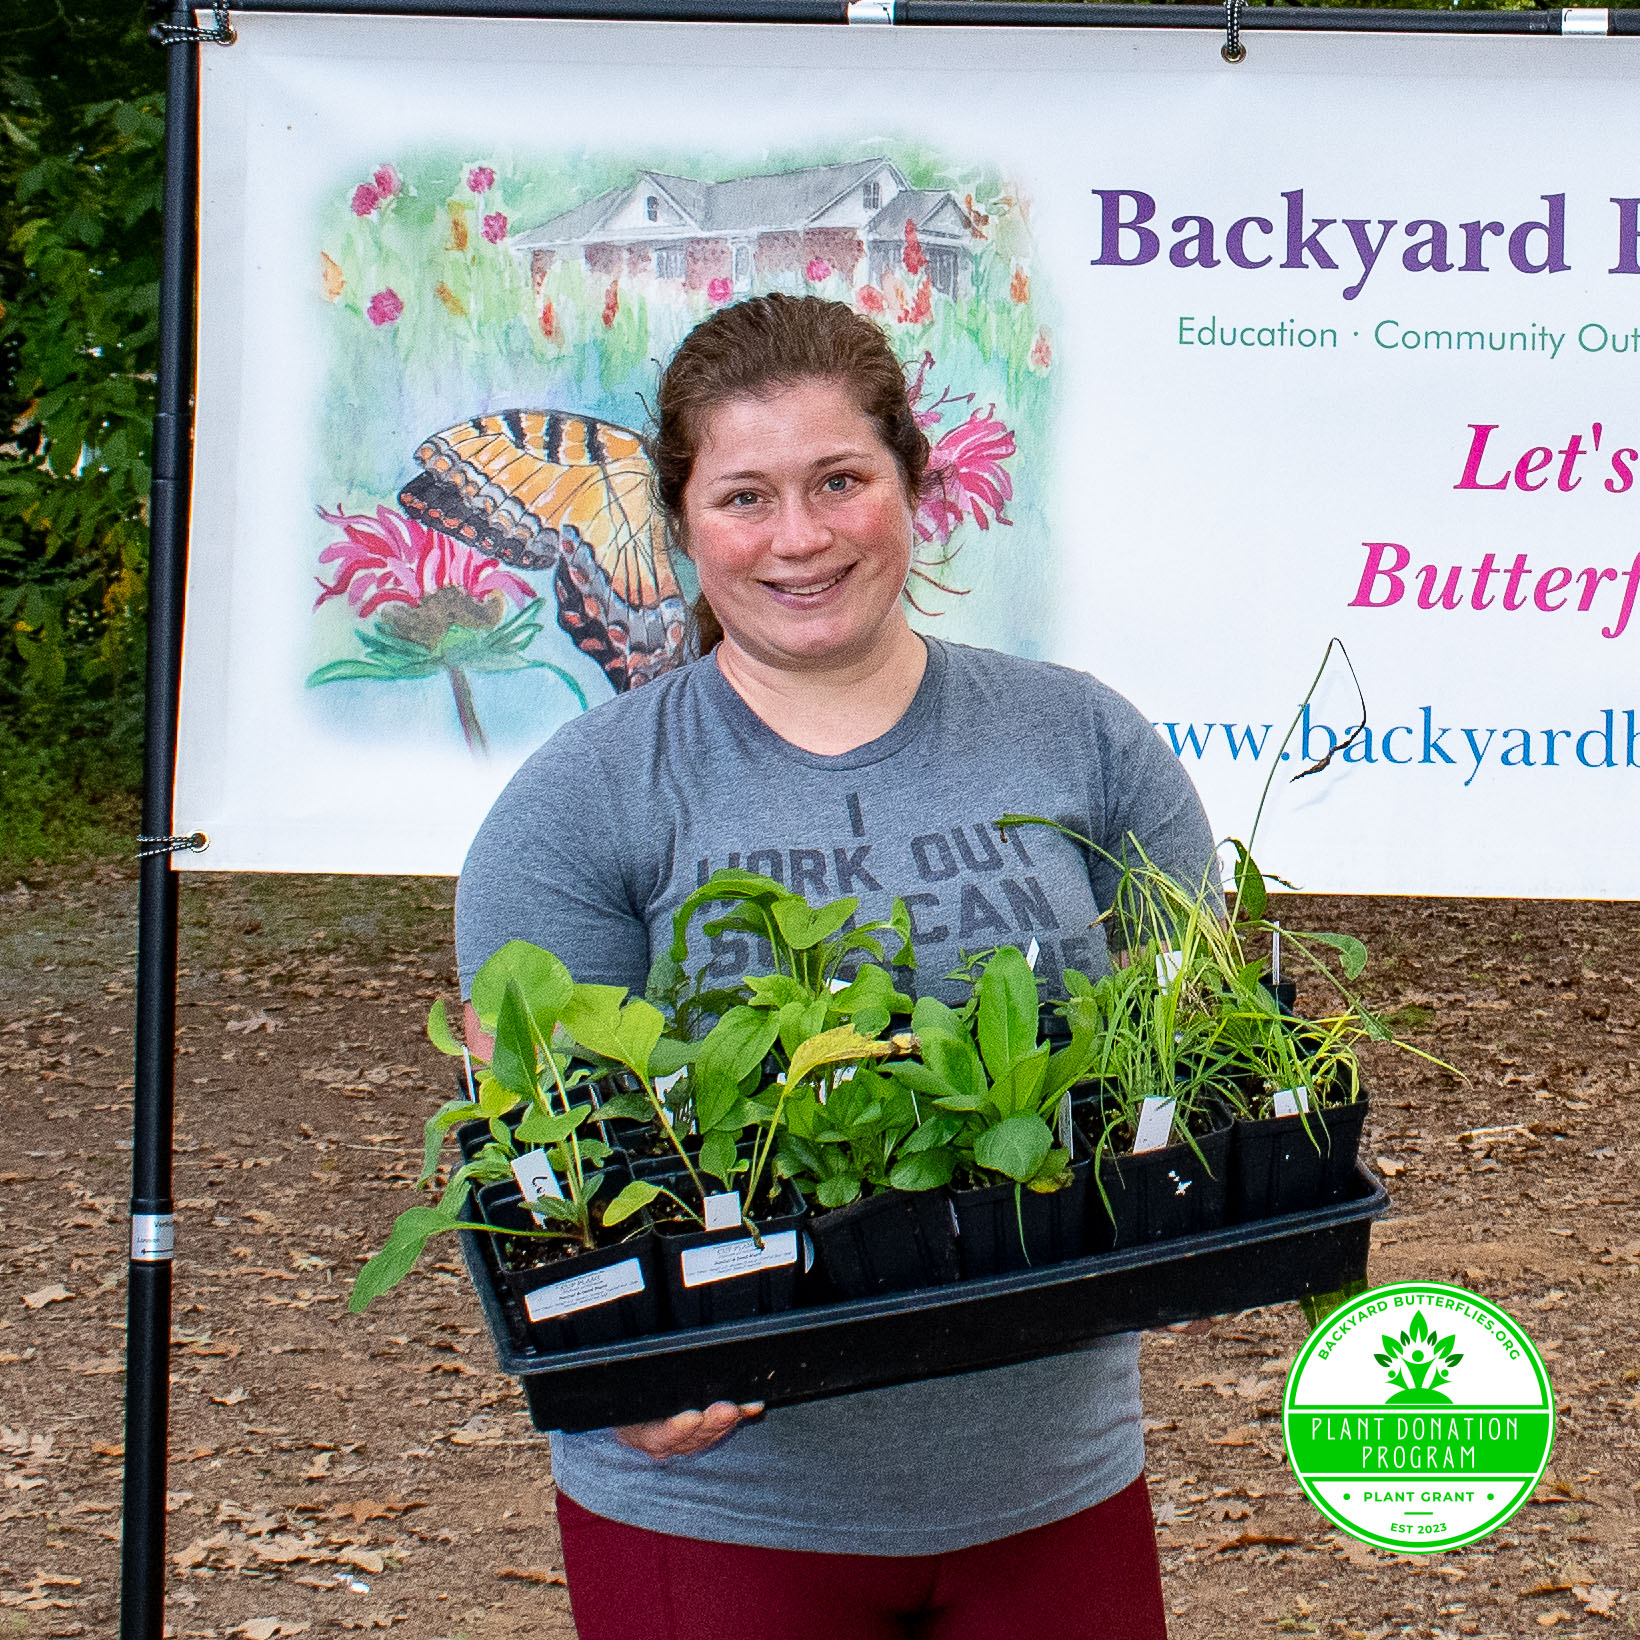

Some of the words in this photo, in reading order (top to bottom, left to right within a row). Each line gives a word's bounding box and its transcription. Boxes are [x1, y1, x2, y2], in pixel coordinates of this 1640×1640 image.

[1090, 189, 1572, 301] Backyard
[1178, 315, 1338, 348] Education
[1373, 319, 1566, 360] Community
[1453, 421, 1638, 494] Let's
[846, 792, 867, 838] I
[909, 820, 1036, 882] OUT
[905, 876, 1060, 945] CAN
